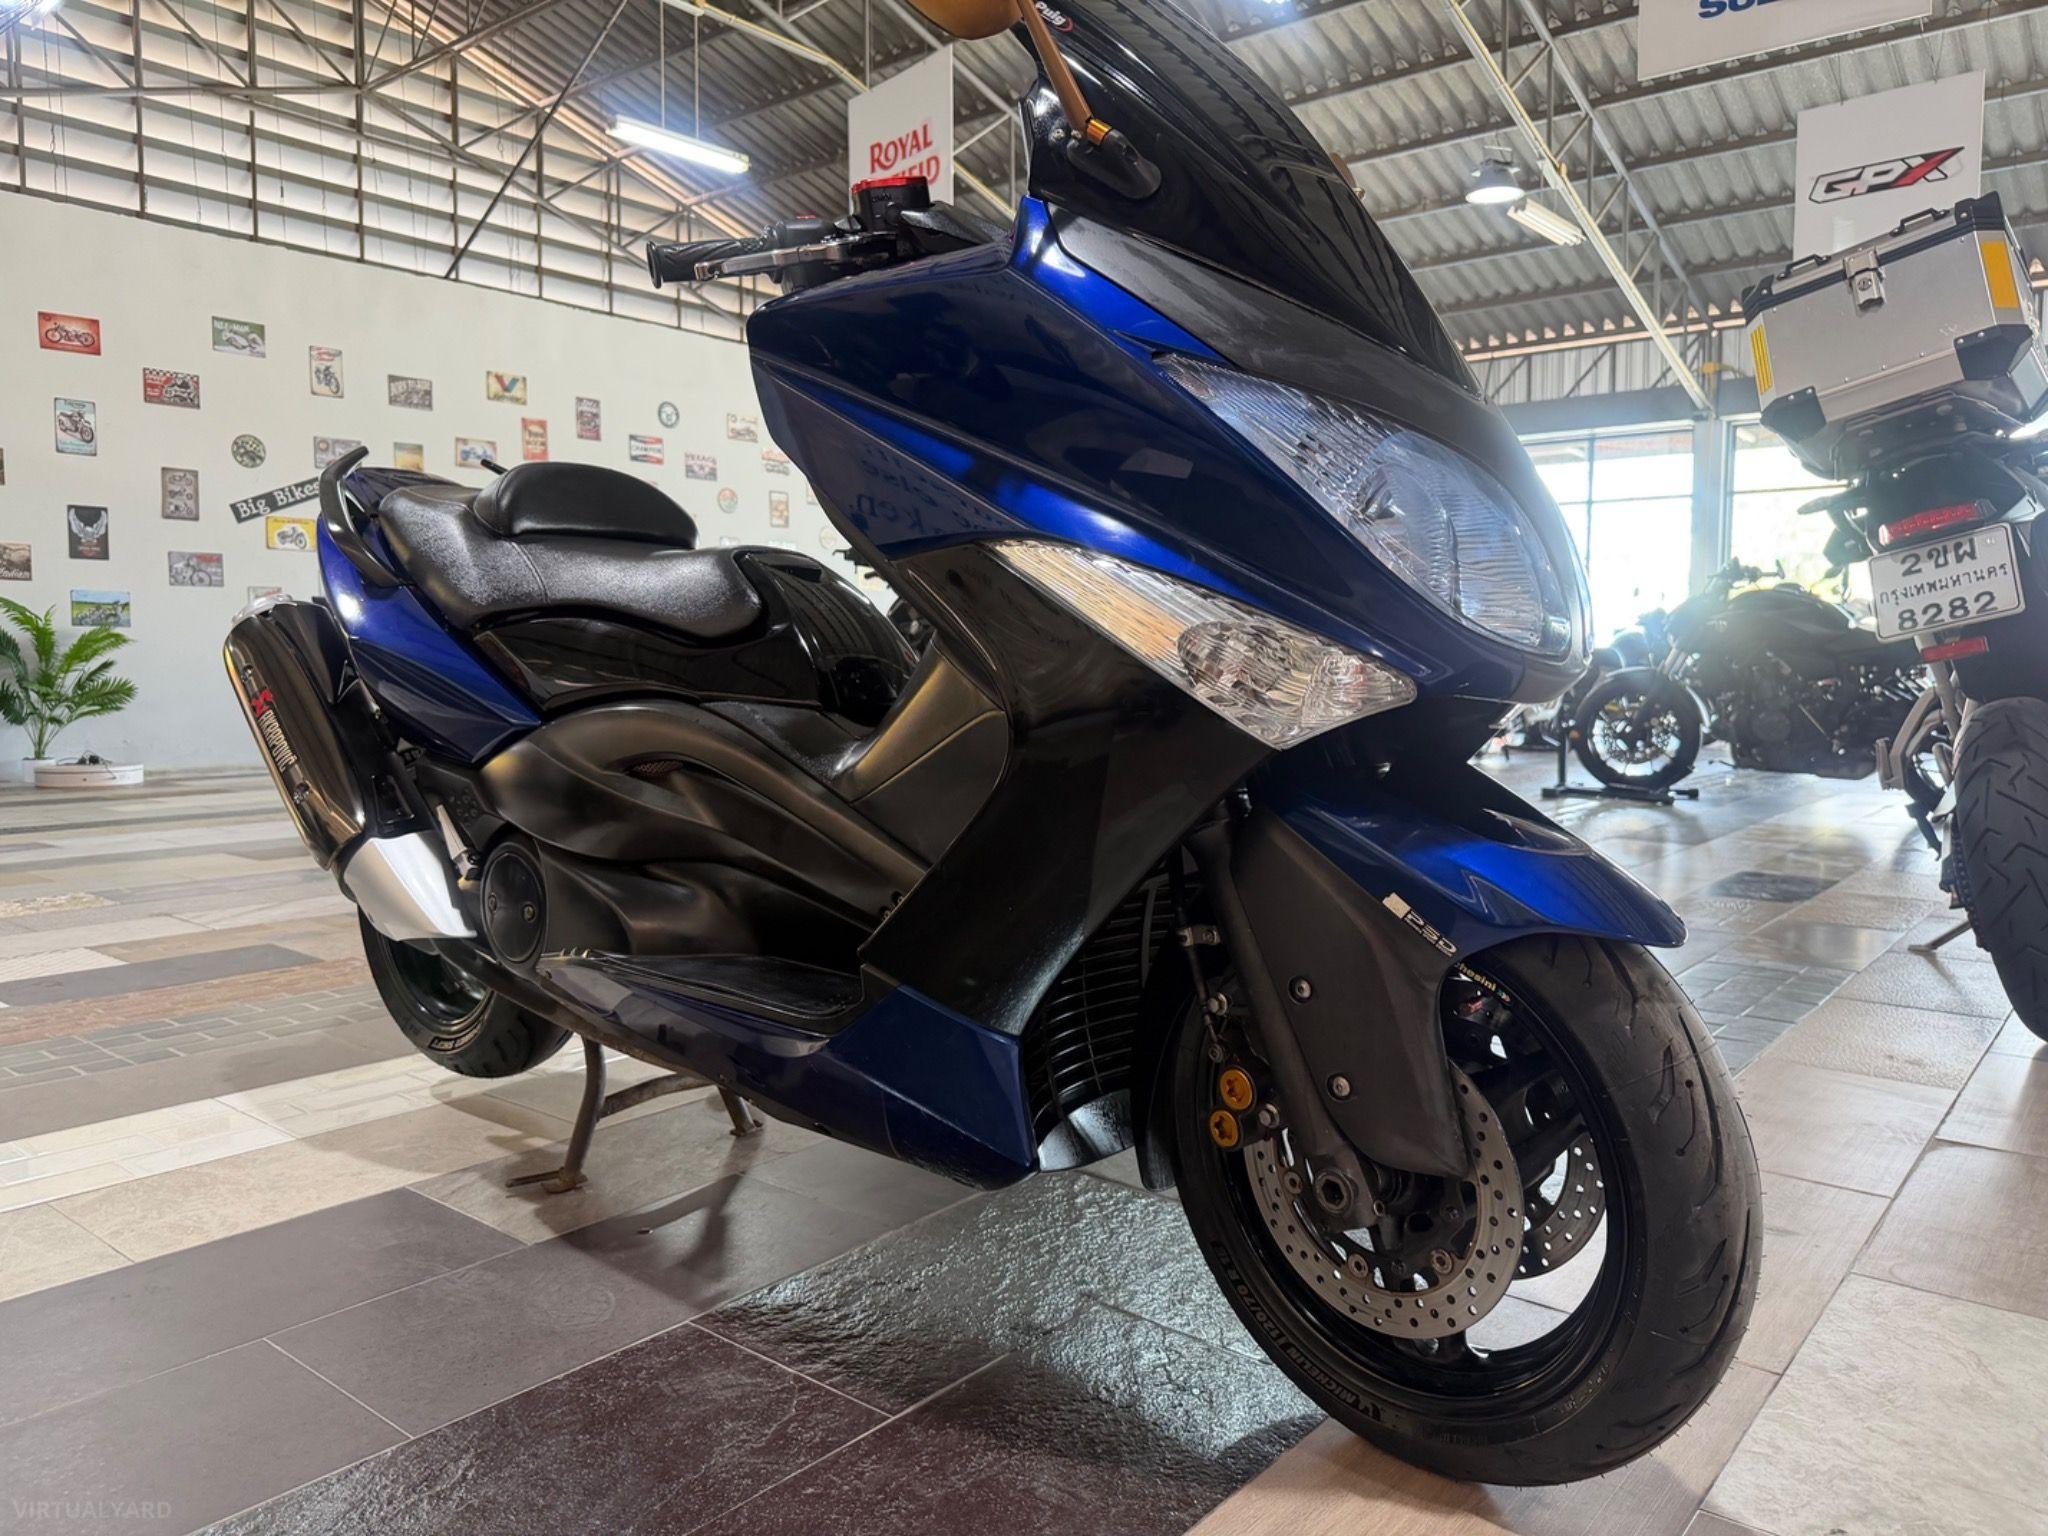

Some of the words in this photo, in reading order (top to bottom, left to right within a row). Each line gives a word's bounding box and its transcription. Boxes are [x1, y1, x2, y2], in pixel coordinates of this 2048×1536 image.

[1035, 1, 1066, 26] Puig
[869, 123, 934, 175] ROYAL
[1808, 146, 1964, 203] GPX
[236, 499, 270, 518] Big
[273, 481, 320, 506] Bikes
[1880, 562, 2008, 606] กรุงเทพมหานคร
[1898, 591, 1998, 631] 8282
[1238, 1285, 1282, 1341] 120/70
[1286, 1347, 1357, 1403] MICHELIN
